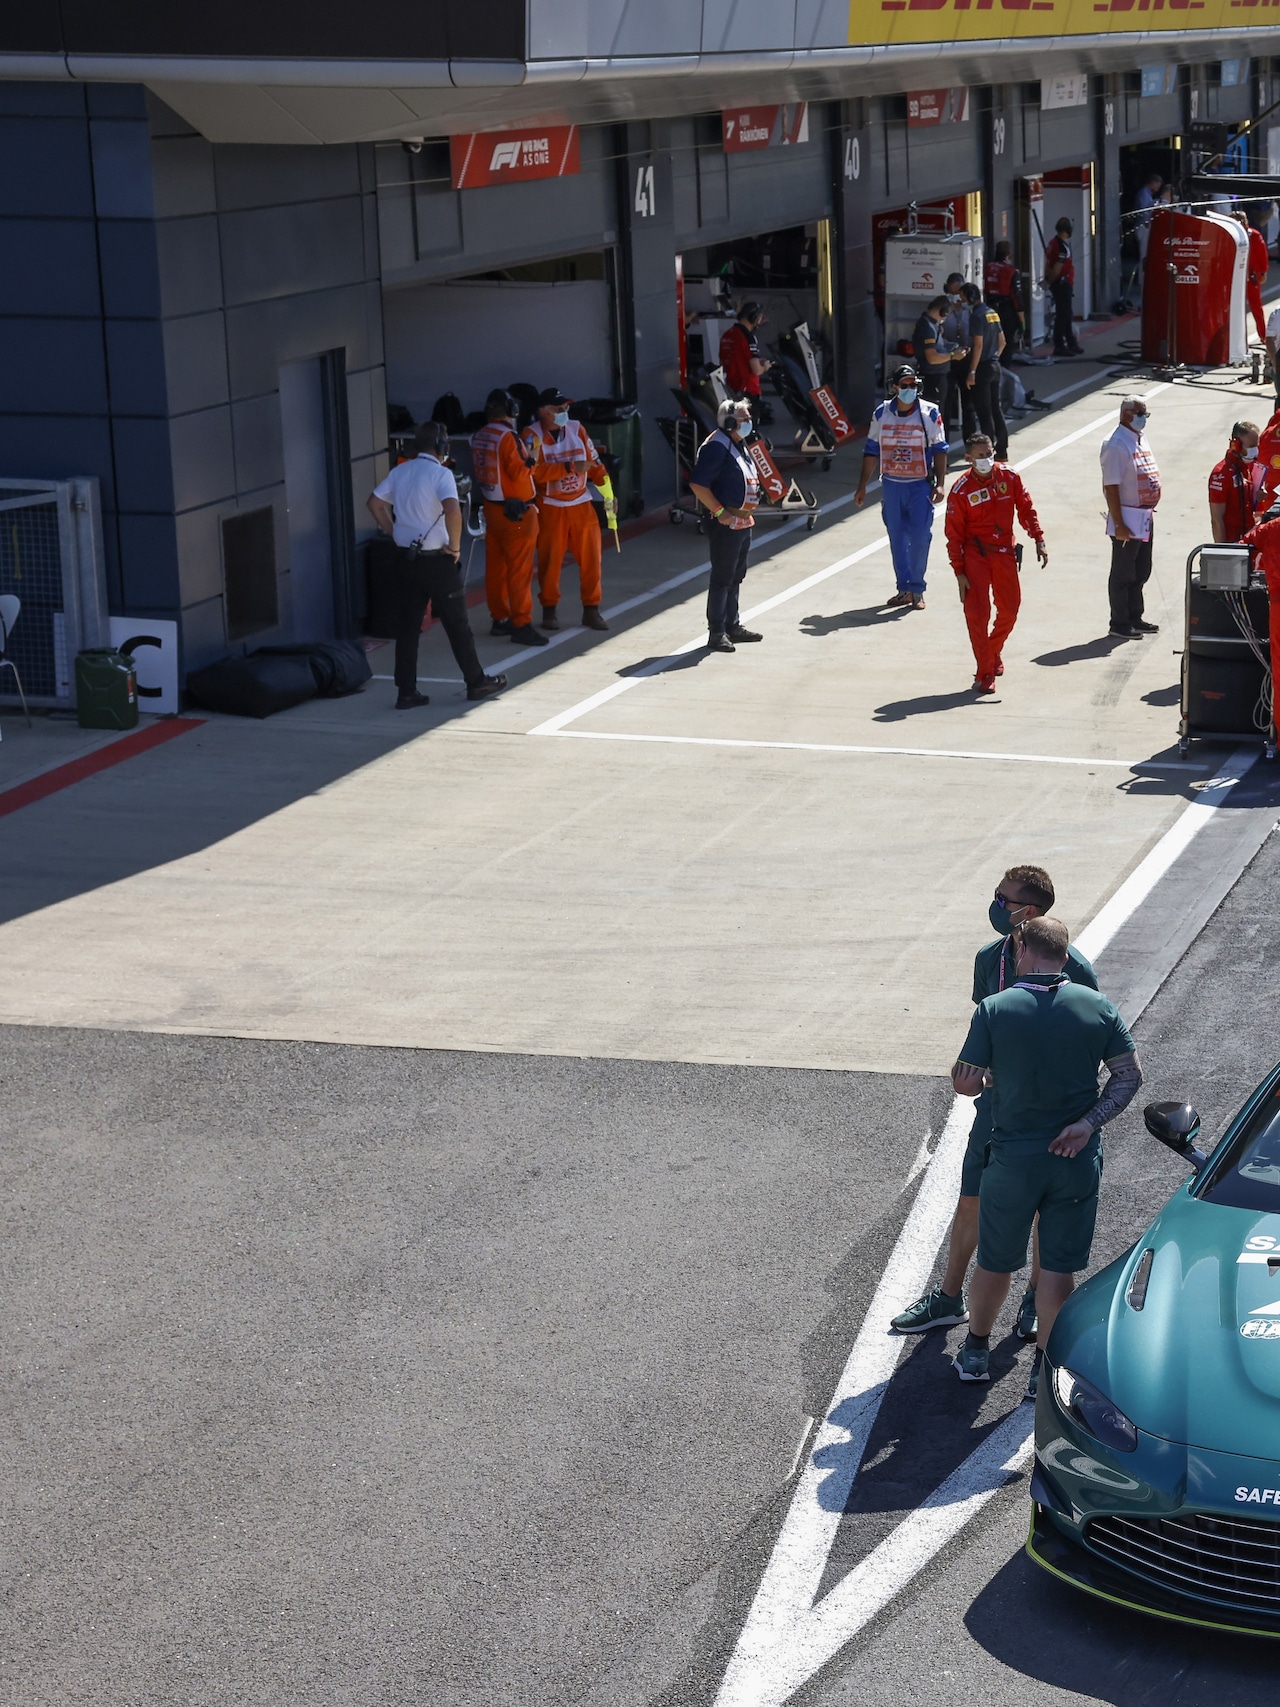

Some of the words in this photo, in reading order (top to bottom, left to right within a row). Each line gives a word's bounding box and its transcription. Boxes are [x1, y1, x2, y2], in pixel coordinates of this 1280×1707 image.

[725, 120, 735, 139] 7
[993, 118, 1005, 155] 39
[522, 141, 534, 153] WE
[534, 138, 549, 152] RACE
[523, 154, 533, 166] AS
[534, 151, 550, 165] ONE
[844, 137, 860, 180] 40
[635, 166, 655, 217] 41
[819, 391, 837, 419] ORLEN
[752, 447, 773, 477] ORLEN
[117, 635, 162, 697] C
